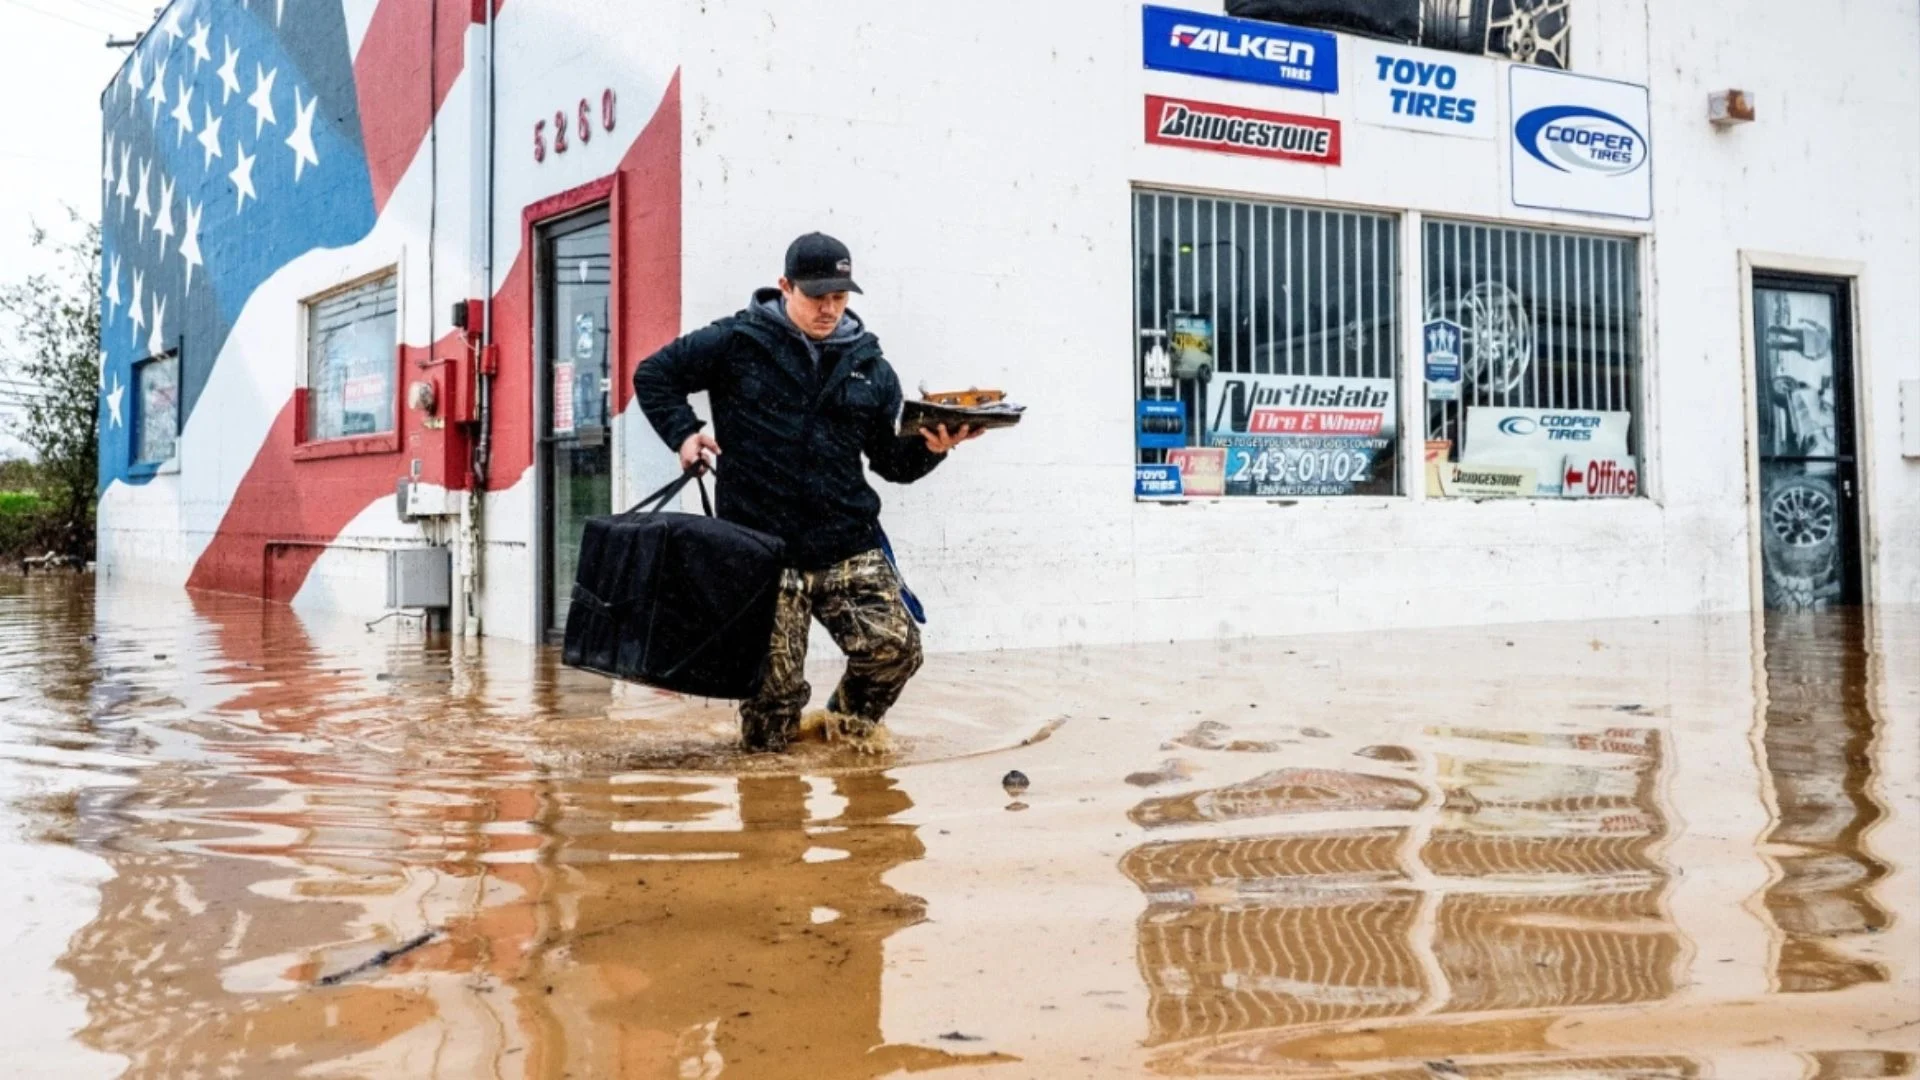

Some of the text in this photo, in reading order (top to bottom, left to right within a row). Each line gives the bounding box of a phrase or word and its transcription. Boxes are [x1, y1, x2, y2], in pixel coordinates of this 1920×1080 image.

[1171, 24, 1314, 67] FALKEN
[1280, 65, 1312, 82] TIRES
[1375, 55, 1456, 90] TOYO
[1389, 88, 1476, 124] TIRES
[534, 88, 616, 163] 5260
[1160, 104, 1329, 155] BRIDGESTONE
[1545, 125, 1633, 152] COOPER
[1589, 147, 1632, 165] TIRES
[1213, 379, 1389, 433] Northstate
[1256, 412, 1295, 430] Tire
[1319, 413, 1379, 432] Wheel
[1539, 415, 1601, 428] COOPER
[1549, 429, 1592, 441] TIRES
[1137, 469, 1167, 480] TOYO
[1233, 451, 1370, 482] 243-0102
[1452, 467, 1523, 486] BRIDGESTONE
[1587, 460, 1636, 495] Office
[1141, 480, 1177, 491] TIRES
